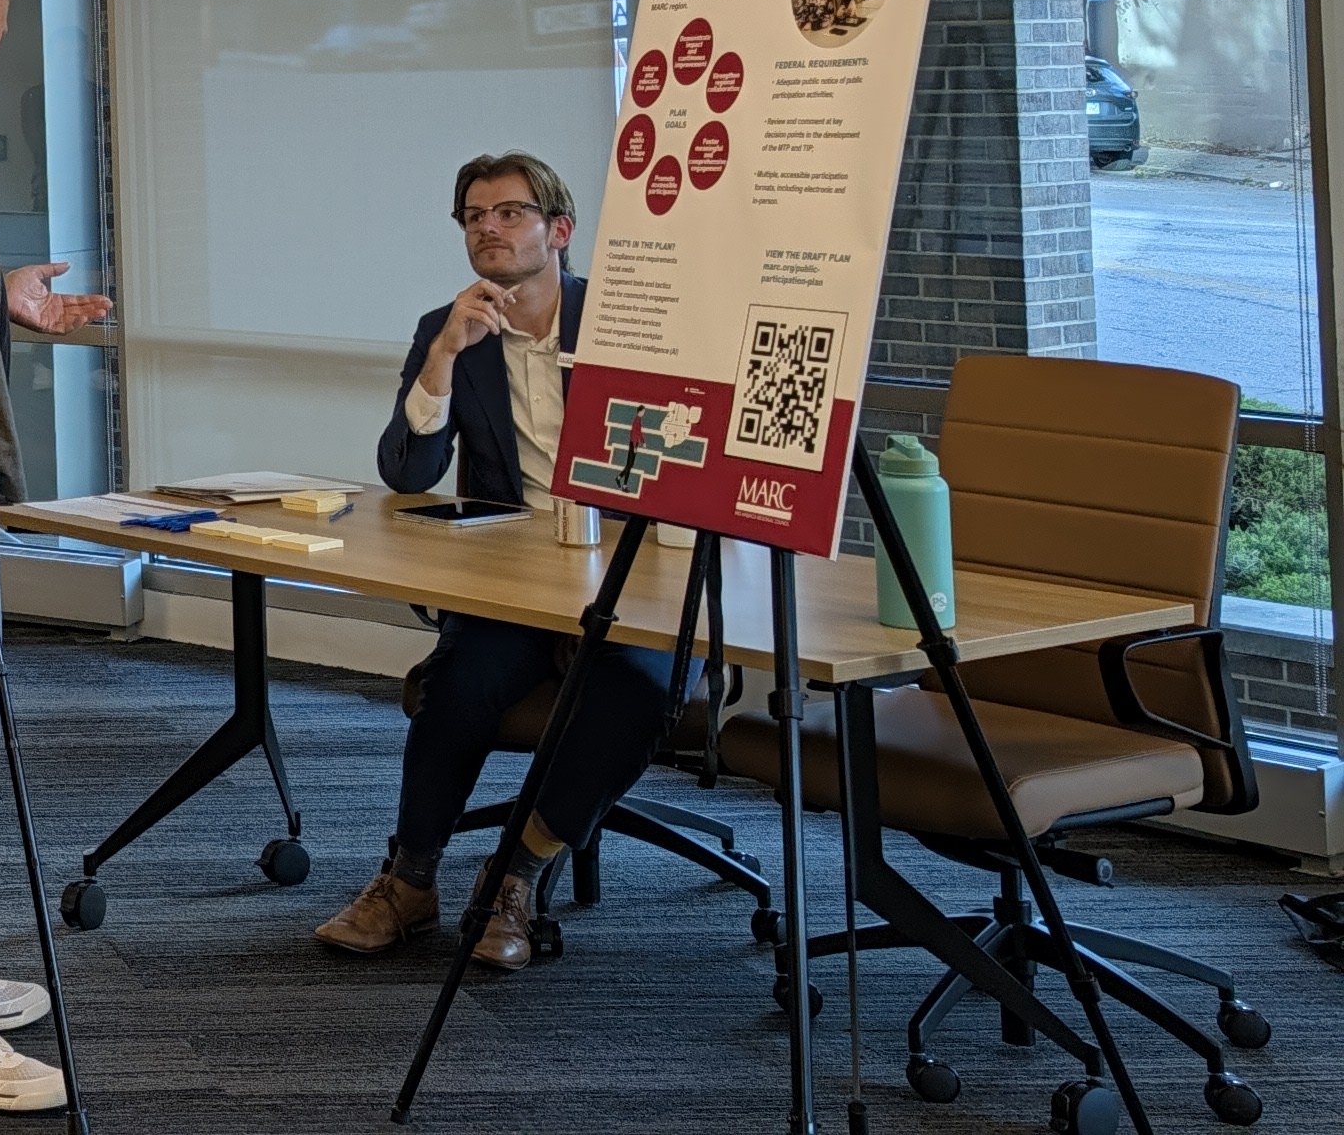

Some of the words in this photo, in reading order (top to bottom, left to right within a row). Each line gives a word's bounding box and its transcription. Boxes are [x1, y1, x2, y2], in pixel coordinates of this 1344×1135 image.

[775, 60, 806, 69] FEDERAL
[808, 58, 869, 68] REQUIREMENTS:
[609, 239, 631, 247] WHAT'S
[633, 240, 639, 248] IN
[641, 241, 654, 249] THE
[655, 242, 675, 251] PLAN?
[766, 250, 784, 258] VIEW
[786, 251, 801, 259] THE
[802, 252, 827, 261] DRAFT
[829, 254, 851, 263] PLAN
[738, 475, 796, 510] MARC
